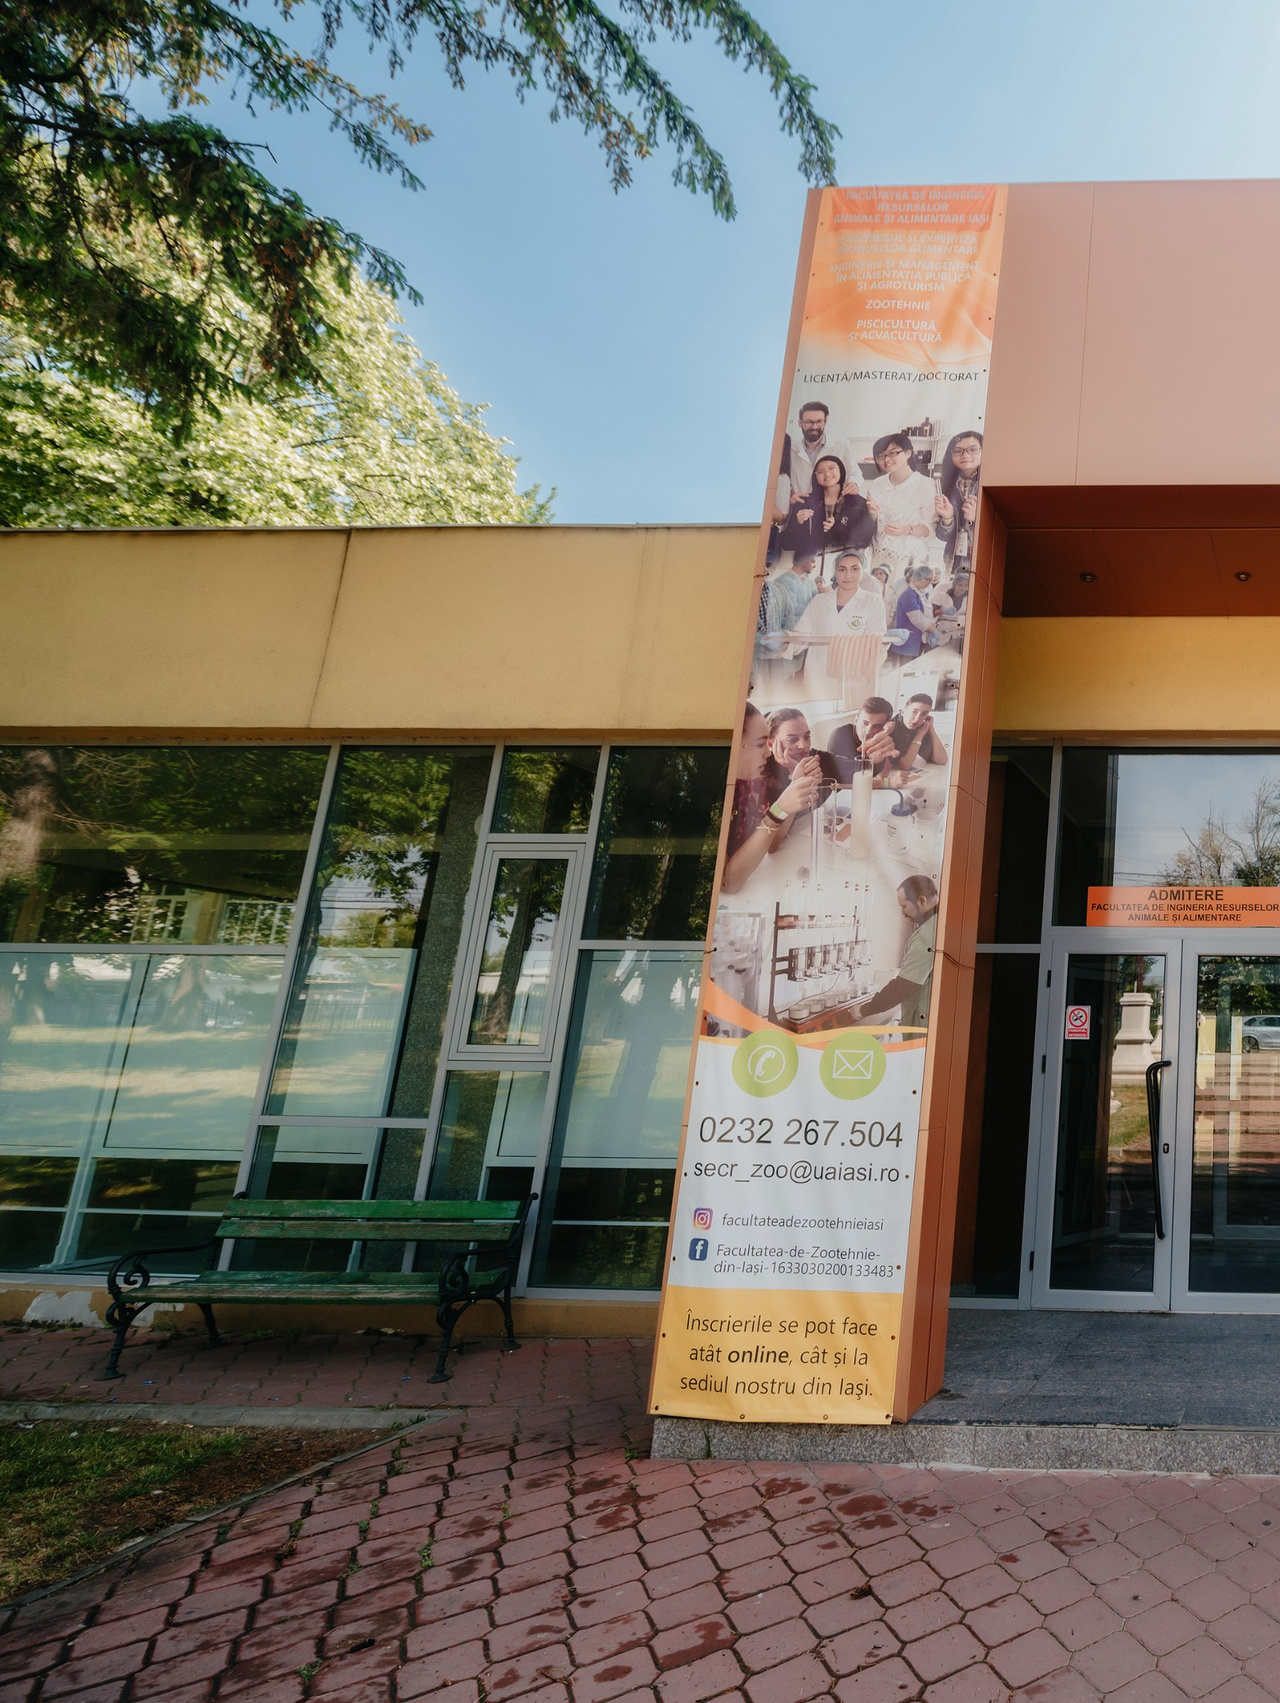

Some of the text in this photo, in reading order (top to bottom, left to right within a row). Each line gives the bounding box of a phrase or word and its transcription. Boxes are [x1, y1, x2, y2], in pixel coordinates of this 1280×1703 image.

[911, 191, 925, 199] DE
[929, 190, 984, 199] INGINERIA
[877, 203, 948, 211] RESURSELOR
[834, 214, 880, 224] ANIMALE
[897, 214, 965, 223] ALIMENTARE
[921, 234, 977, 244] EXPERTIZA
[831, 260, 882, 272] INGINERIE
[898, 260, 981, 271] MANAGEMENT
[870, 281, 945, 291] AGROTURISM
[865, 300, 931, 310] ZOOTEHNIE
[857, 319, 936, 331] PISCICULTURĂ
[860, 331, 942, 342] ACVACULTURĂ
[1148, 890, 1224, 901] ADMITERE
[1172, 914, 1180, 923] ȘI
[700, 1116, 903, 1148] 0232 267.504
[694, 1160, 900, 1184] secr_zoo@uaiasi.ro
[722, 1213, 884, 1231] facultateadezootehnieiasi
[716, 1244, 881, 1261] Facultatea-de-Zootehnie-
[686, 1308, 878, 1338] Înscrierile se pot face
[689, 1344, 722, 1363] atât
[728, 1345, 793, 1366] online,
[800, 1346, 828, 1364] cât
[853, 1348, 868, 1366] la
[680, 1374, 729, 1394] sediul
[734, 1378, 796, 1395] nostru
[802, 1377, 832, 1395] din
